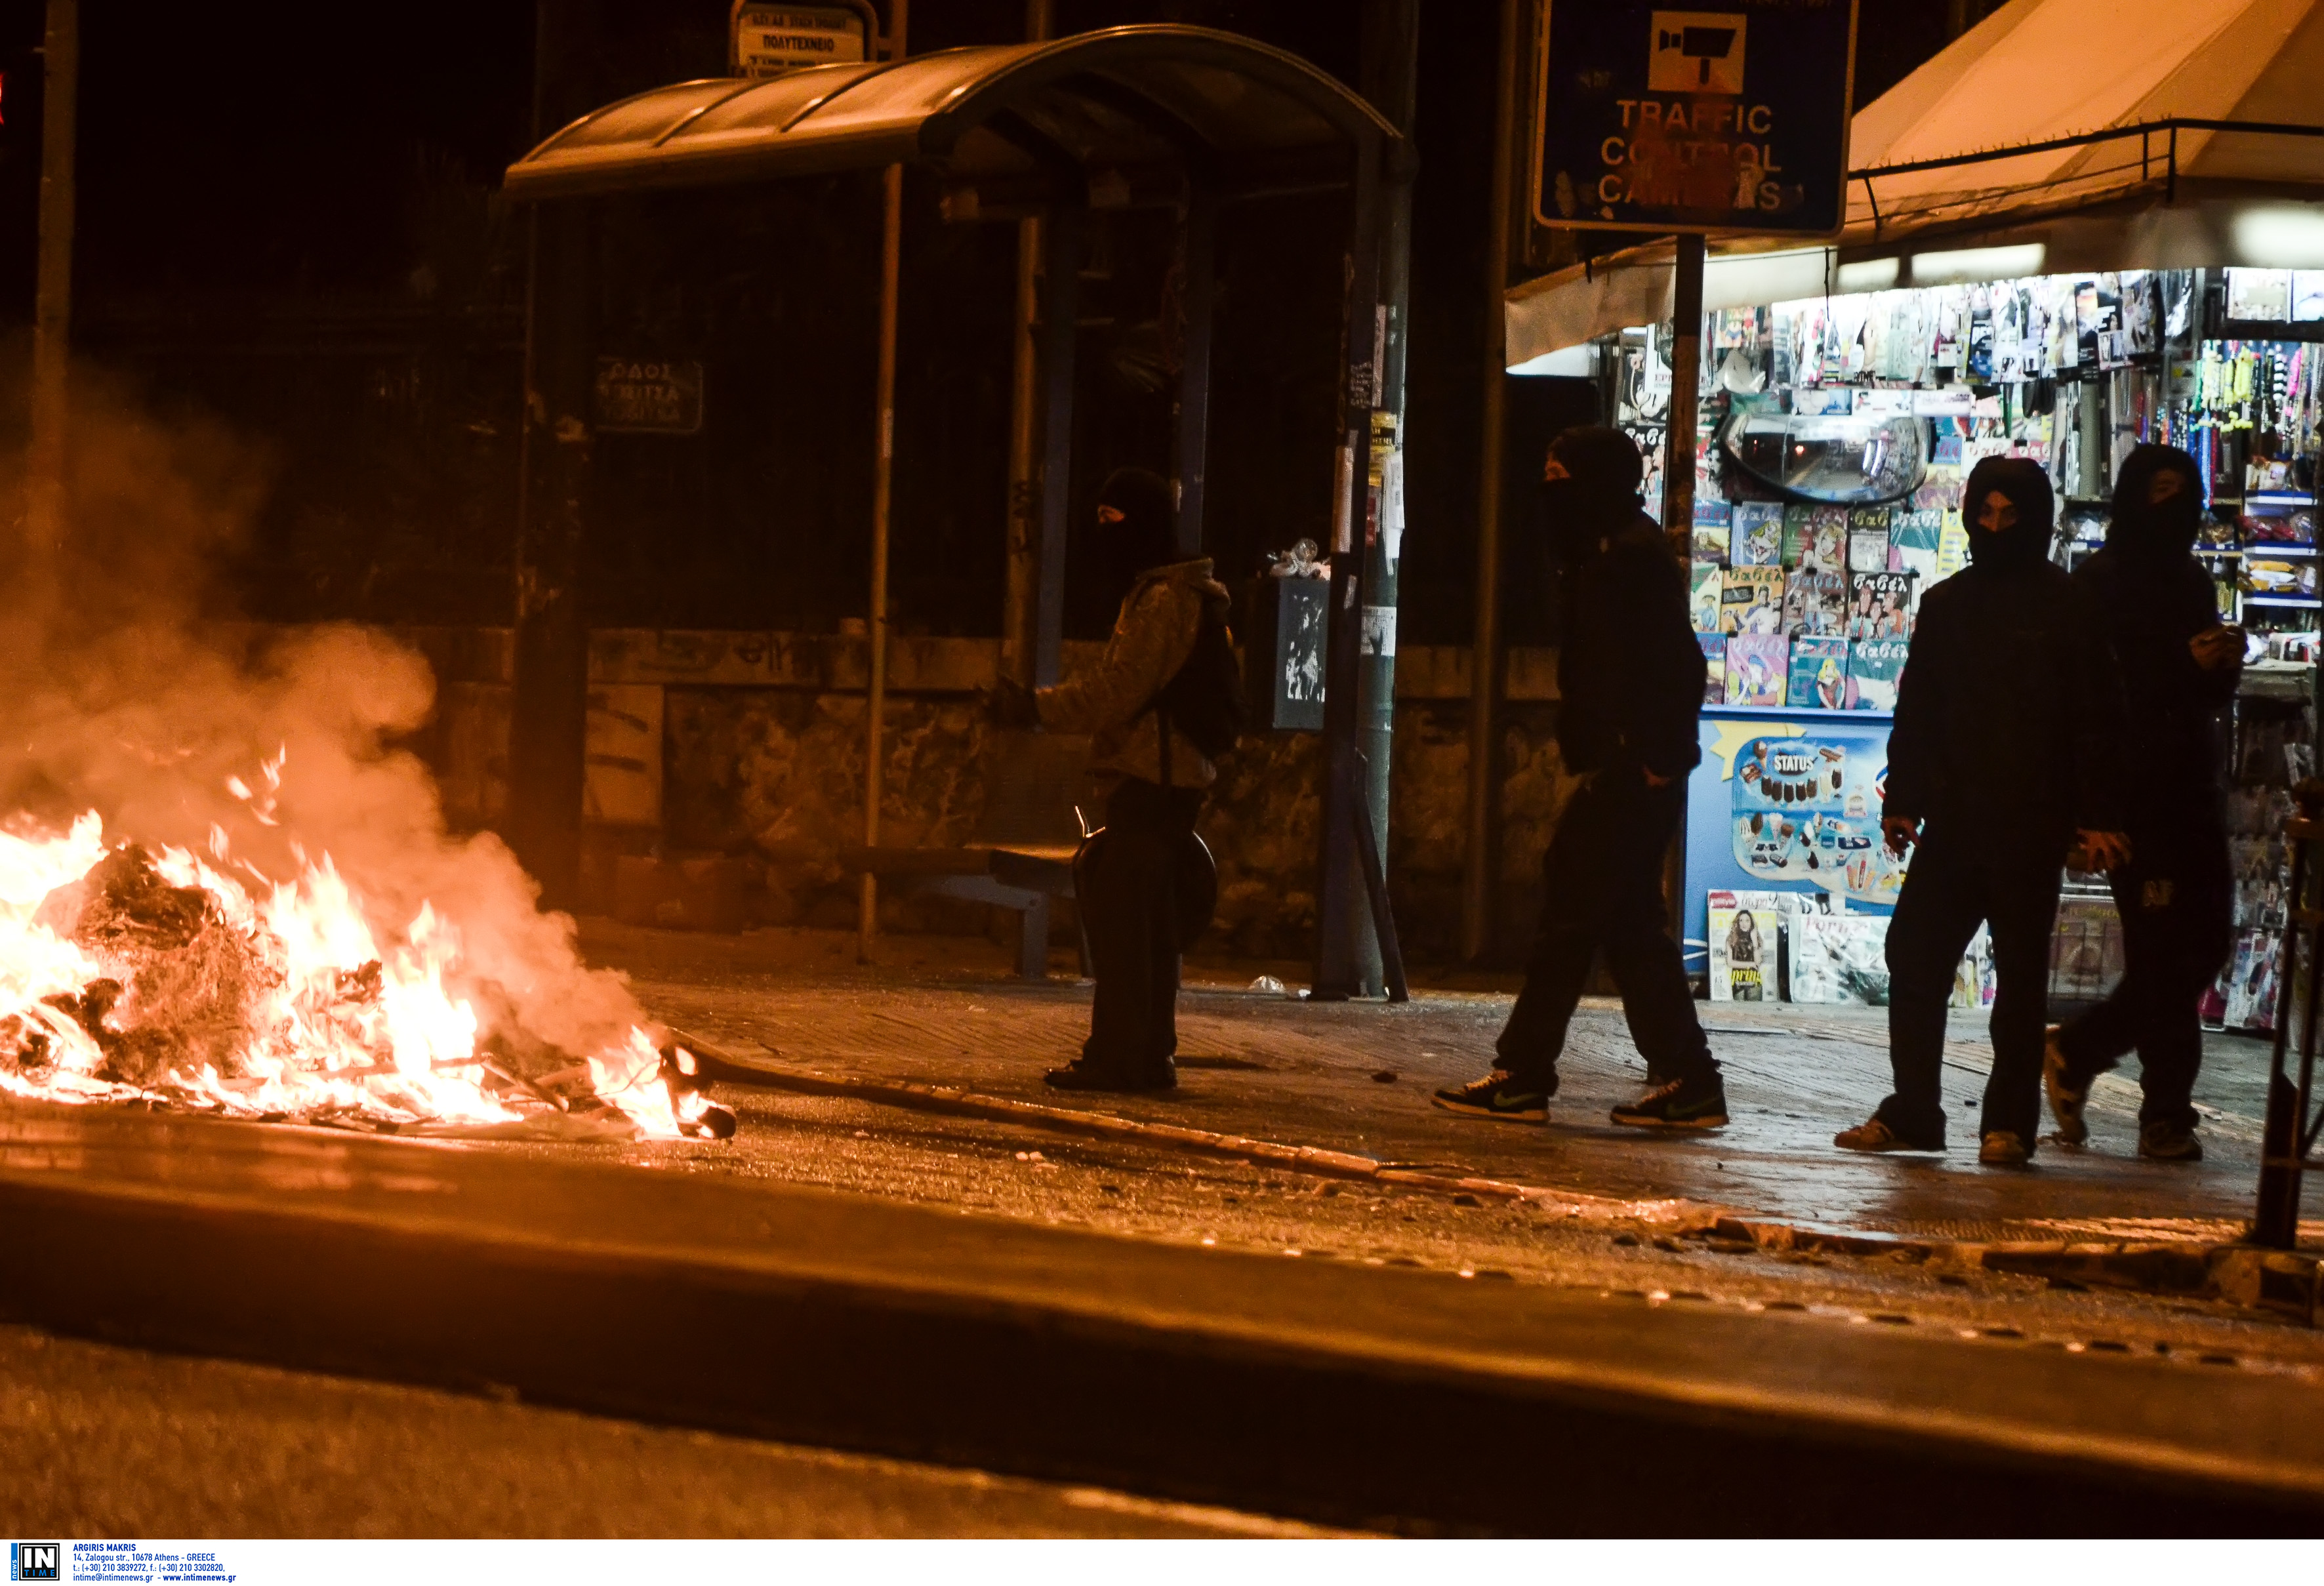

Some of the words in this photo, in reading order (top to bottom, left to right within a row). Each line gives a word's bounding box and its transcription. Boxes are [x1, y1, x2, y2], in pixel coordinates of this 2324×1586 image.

[763, 35, 835, 52] ΠΟΛΥΤΕΧΝΕΙΟ
[1616, 100, 1772, 135] TRAFFIC
[1774, 756, 1814, 771] STATUS
